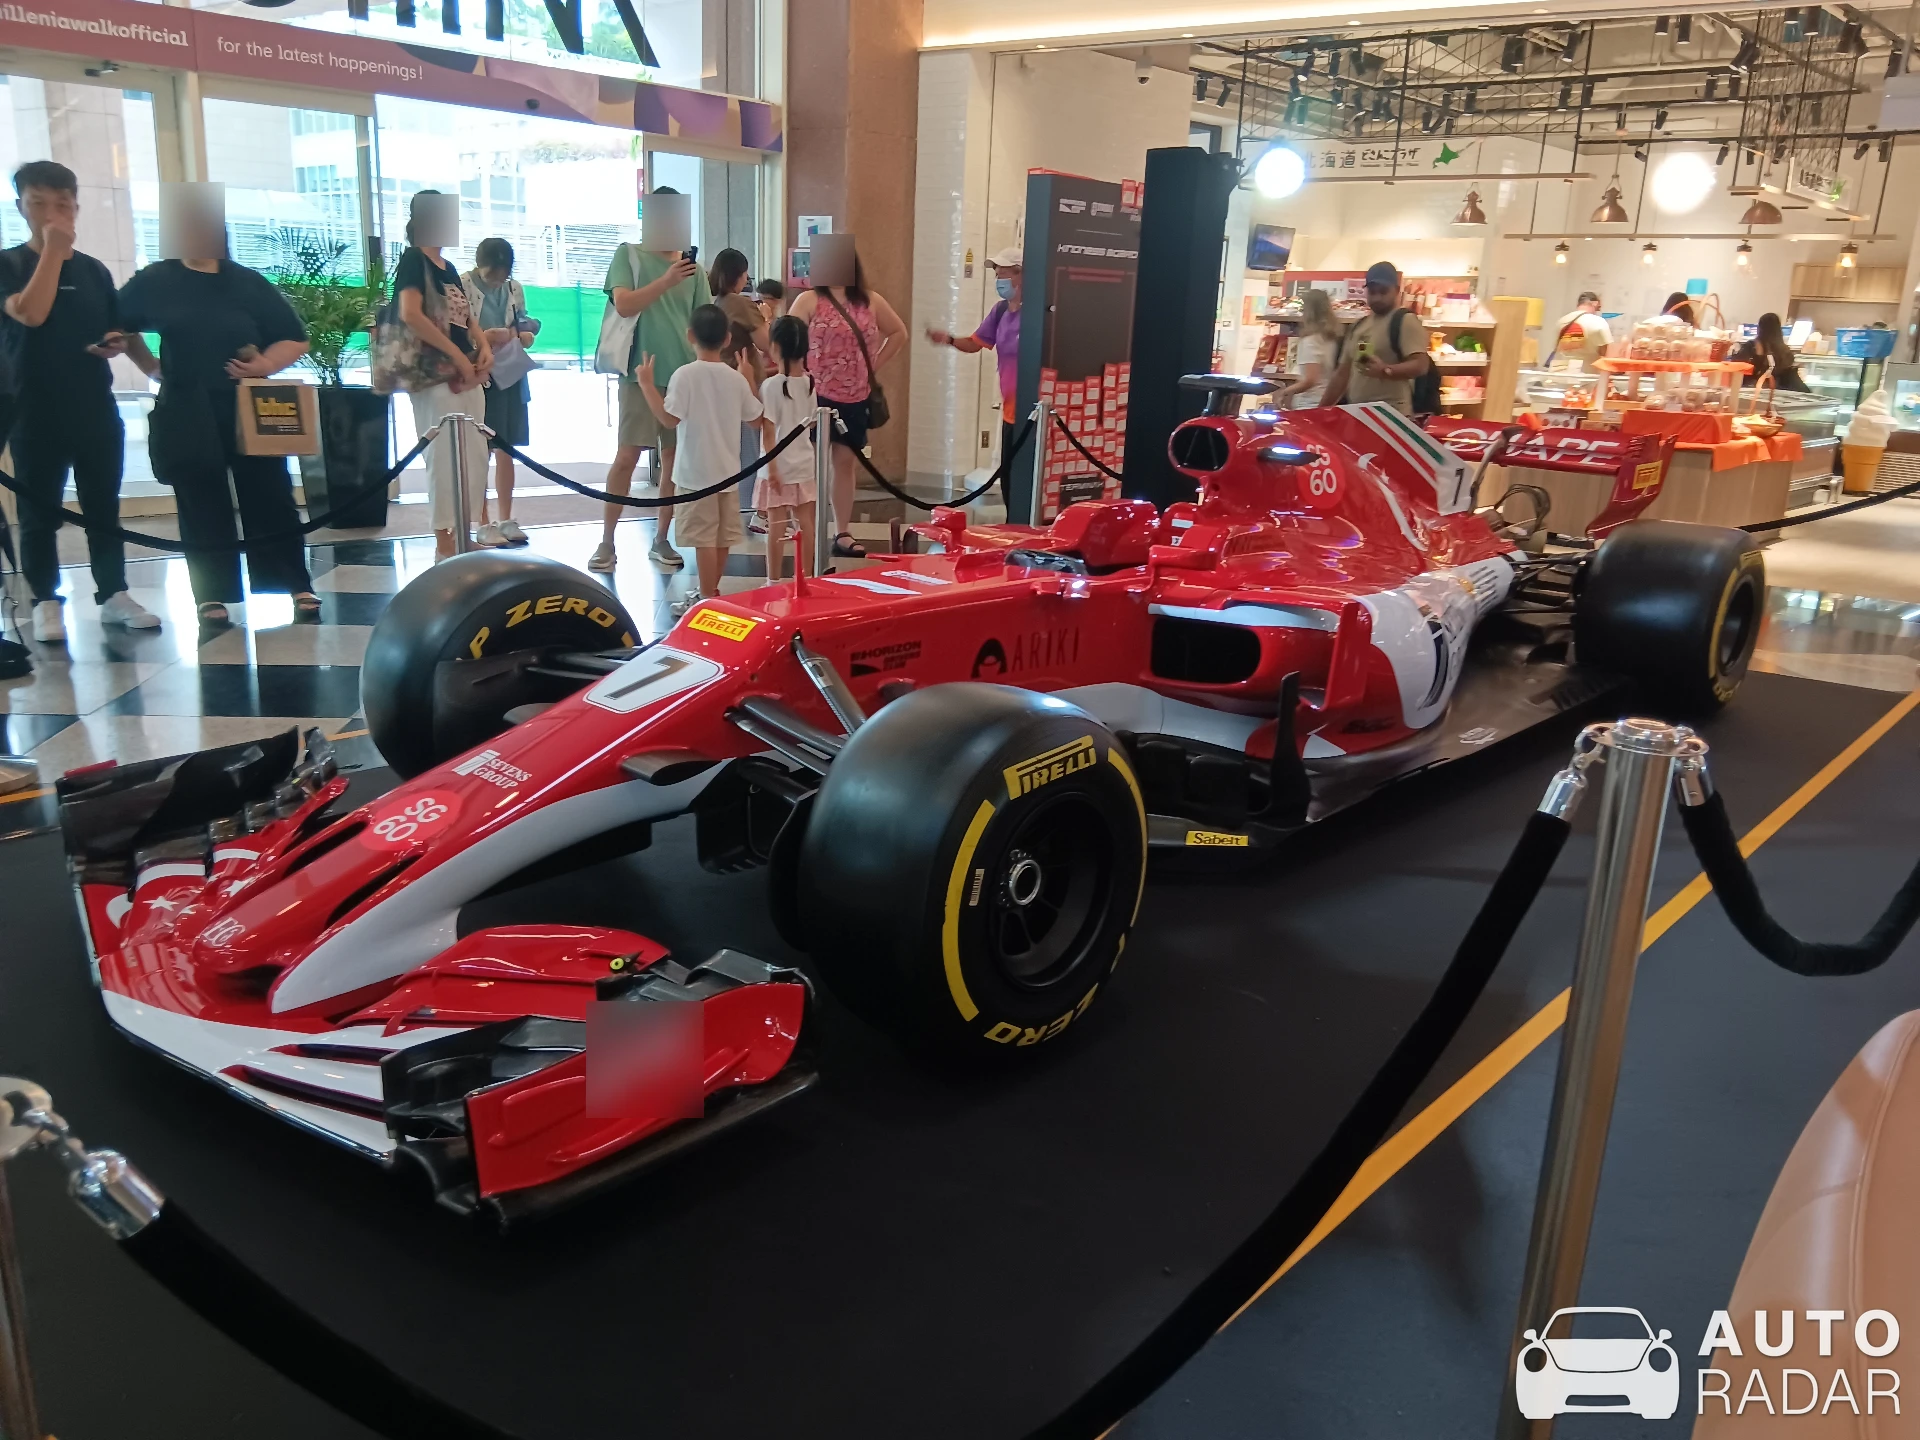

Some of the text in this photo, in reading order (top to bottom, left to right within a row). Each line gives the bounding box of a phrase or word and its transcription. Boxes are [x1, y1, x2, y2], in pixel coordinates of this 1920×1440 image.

[0, 4, 189, 47] illeniawalkofficial
[217, 36, 423, 81] for the latest happenings!
[1310, 468, 1337, 496] 60
[470, 595, 617, 659] P ZERO
[695, 613, 749, 637] PIRELLI
[1012, 626, 1080, 672] ARIKI
[603, 654, 694, 701] 7
[473, 767, 519, 790] GROUP
[487, 757, 533, 782] SEVENS
[1003, 735, 1097, 800] PIRELLI
[404, 797, 449, 823] SG
[373, 815, 419, 842] 60
[1192, 832, 1241, 846] Sabelt
[983, 981, 1099, 1047] ZERO
